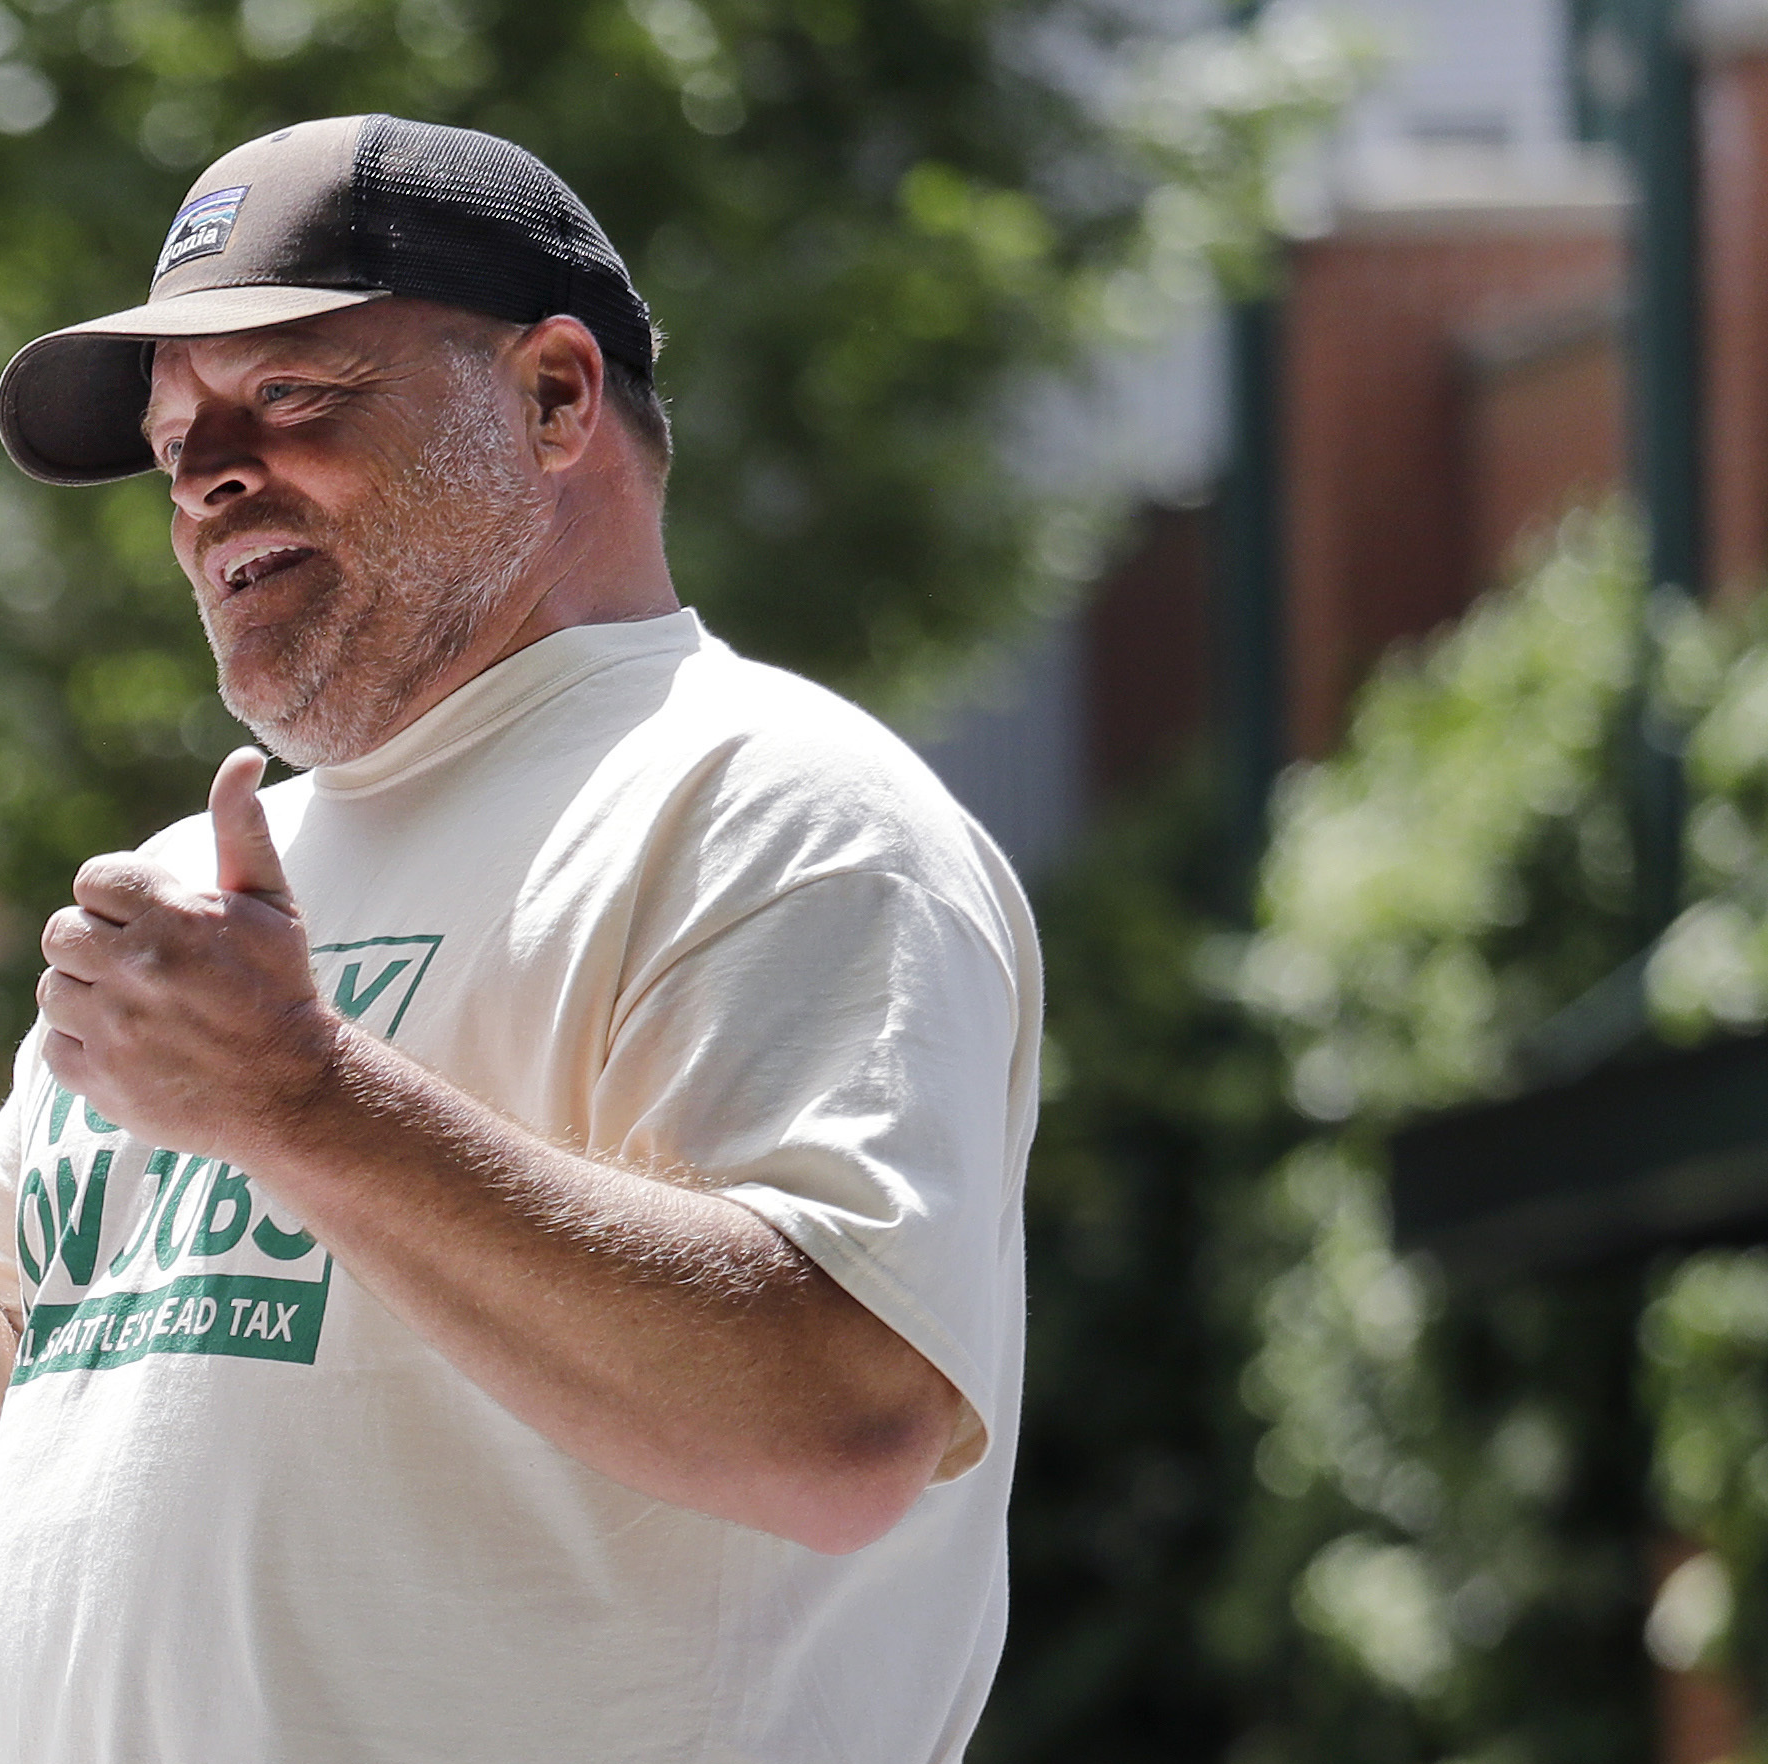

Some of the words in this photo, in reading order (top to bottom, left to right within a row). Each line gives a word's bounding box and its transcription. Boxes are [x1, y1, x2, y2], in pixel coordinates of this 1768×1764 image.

[18, 1150, 114, 1286] ON
[150, 1297, 217, 1337] EAD
[229, 1298, 300, 1342] TAX
